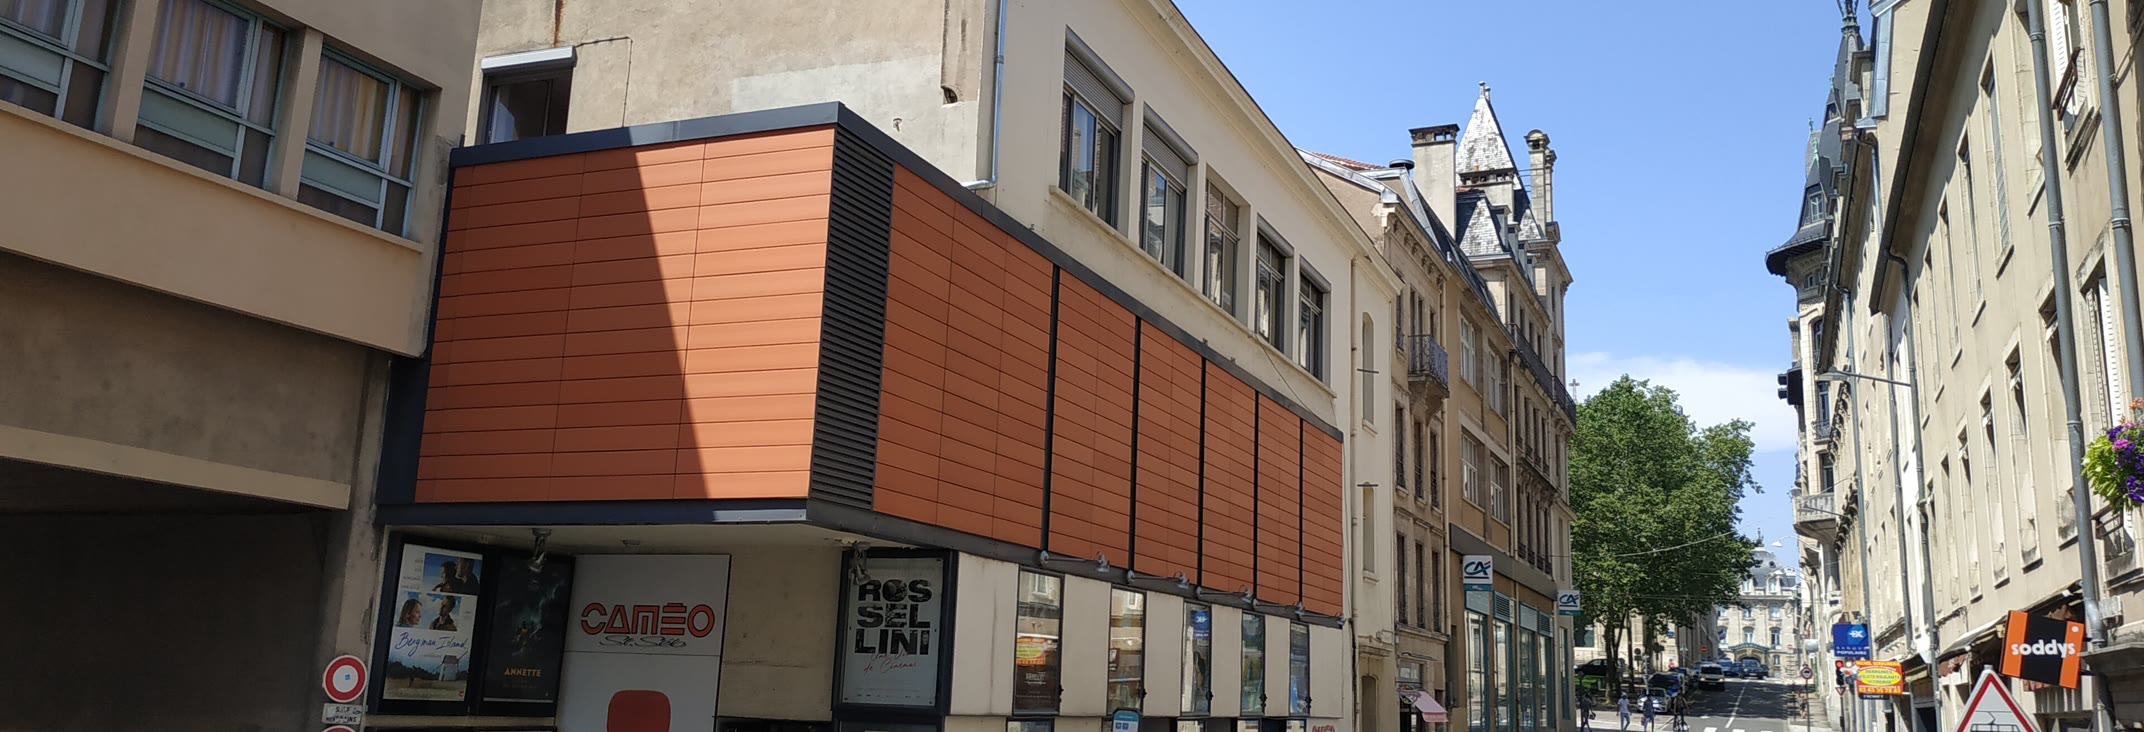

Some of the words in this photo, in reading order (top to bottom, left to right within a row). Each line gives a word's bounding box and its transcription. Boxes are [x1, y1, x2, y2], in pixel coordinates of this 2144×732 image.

[858, 578, 932, 602] ROS
[857, 603, 931, 628] SEL
[395, 632, 437, 657] Bergman
[436, 636, 469, 651] Island
[854, 629, 930, 655] LINI
[2010, 639, 2077, 659] soddys
[504, 667, 542, 678] ANNETTE
